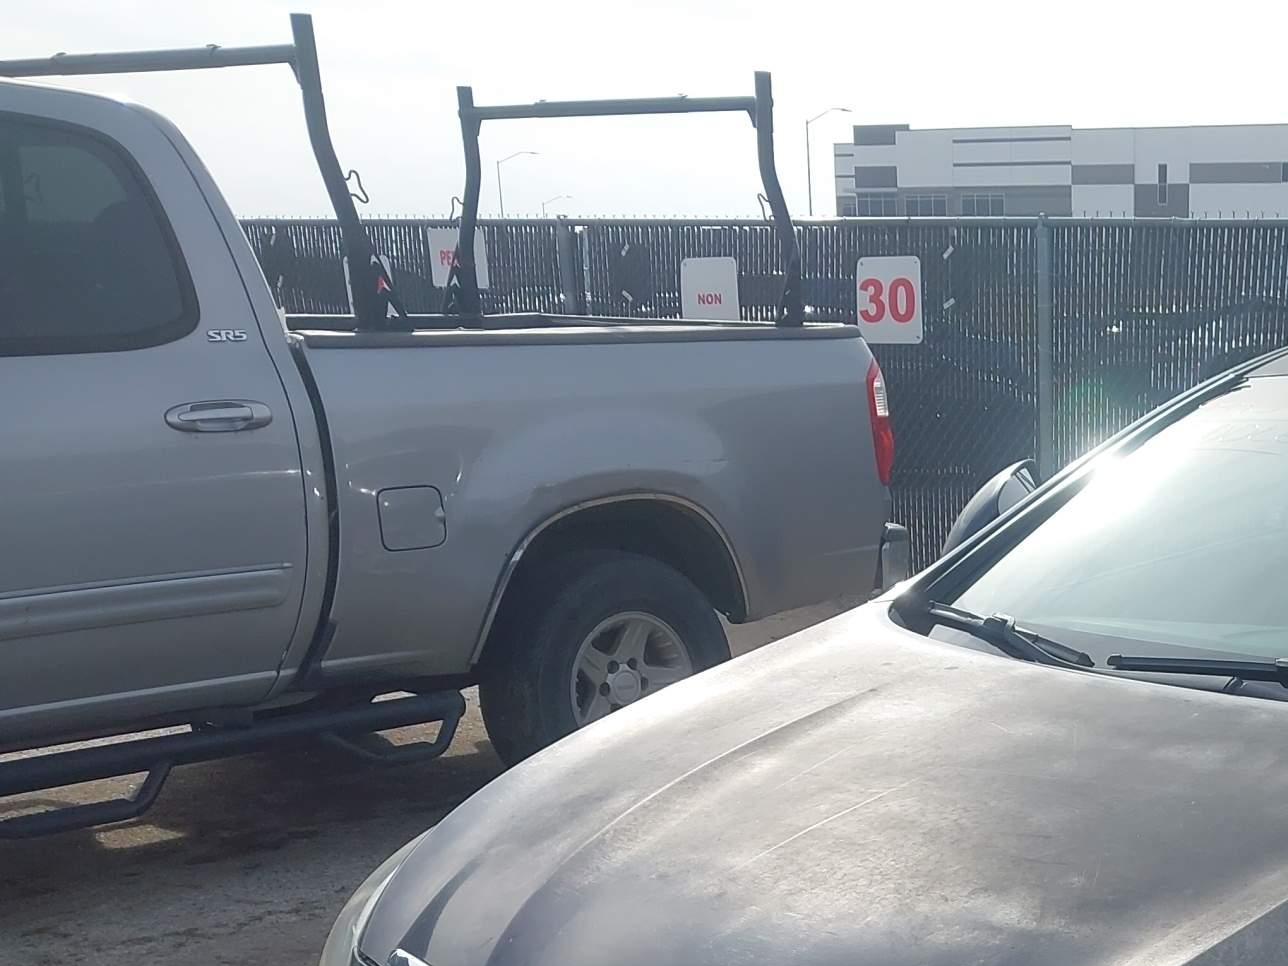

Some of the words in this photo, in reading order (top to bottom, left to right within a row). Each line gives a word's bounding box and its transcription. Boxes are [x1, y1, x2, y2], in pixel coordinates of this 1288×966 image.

[697, 293, 722, 305] NON
[859, 277, 916, 323] 30
[207, 329, 248, 342] SR5
